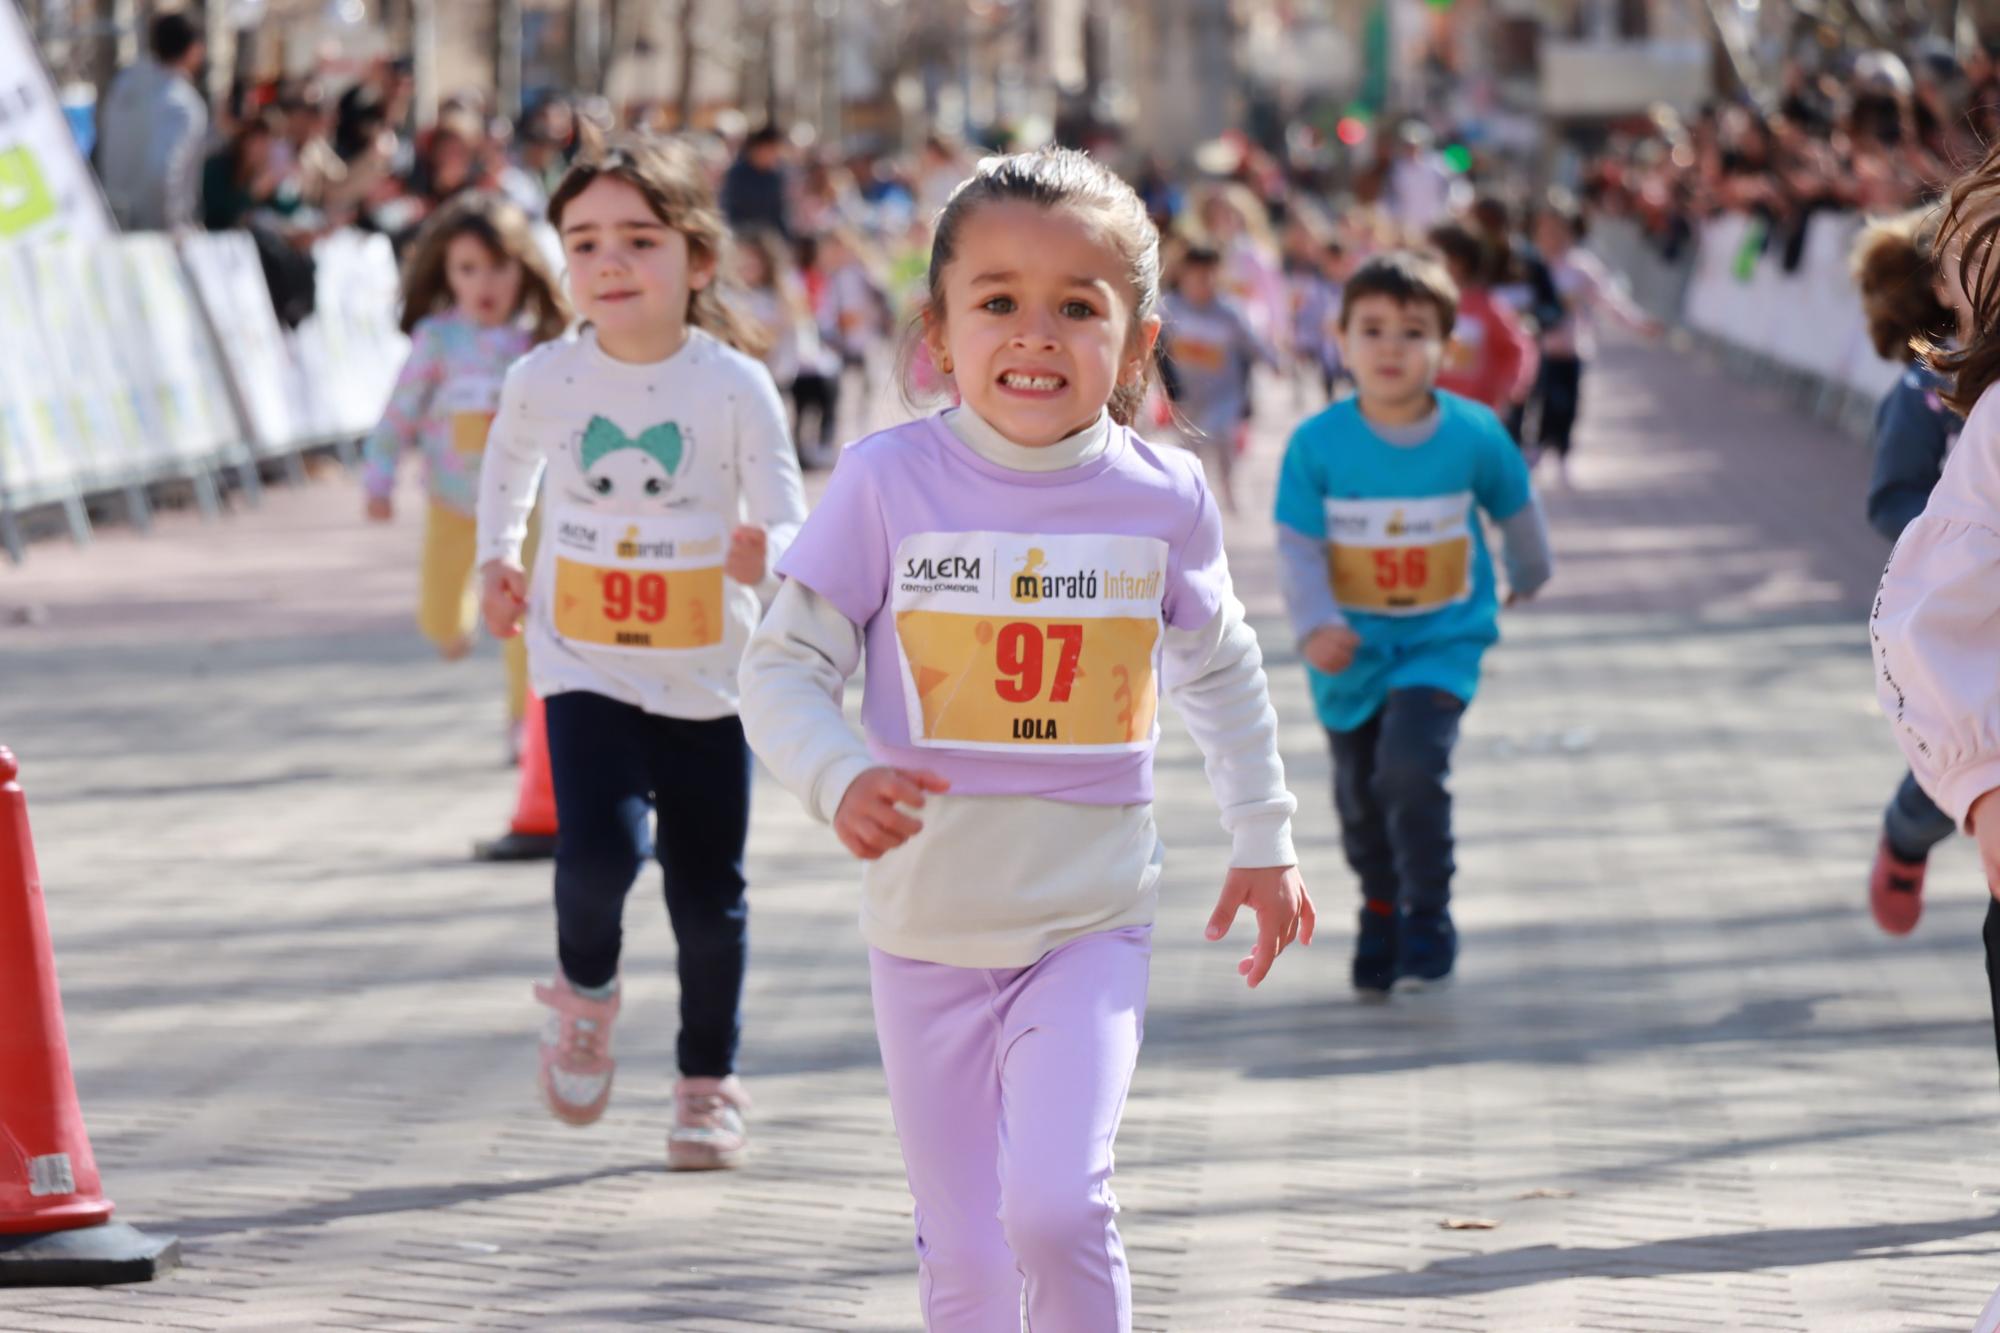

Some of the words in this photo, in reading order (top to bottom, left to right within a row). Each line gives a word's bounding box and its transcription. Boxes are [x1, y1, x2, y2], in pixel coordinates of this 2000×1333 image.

[904, 556, 980, 580] SALERA
[1016, 569, 1097, 599] marató
[1103, 569, 1161, 600] Infantil
[1372, 547, 1428, 590] 56
[603, 571, 668, 624] 99
[995, 622, 1083, 703] 97
[1012, 718, 1057, 739] LOLA
